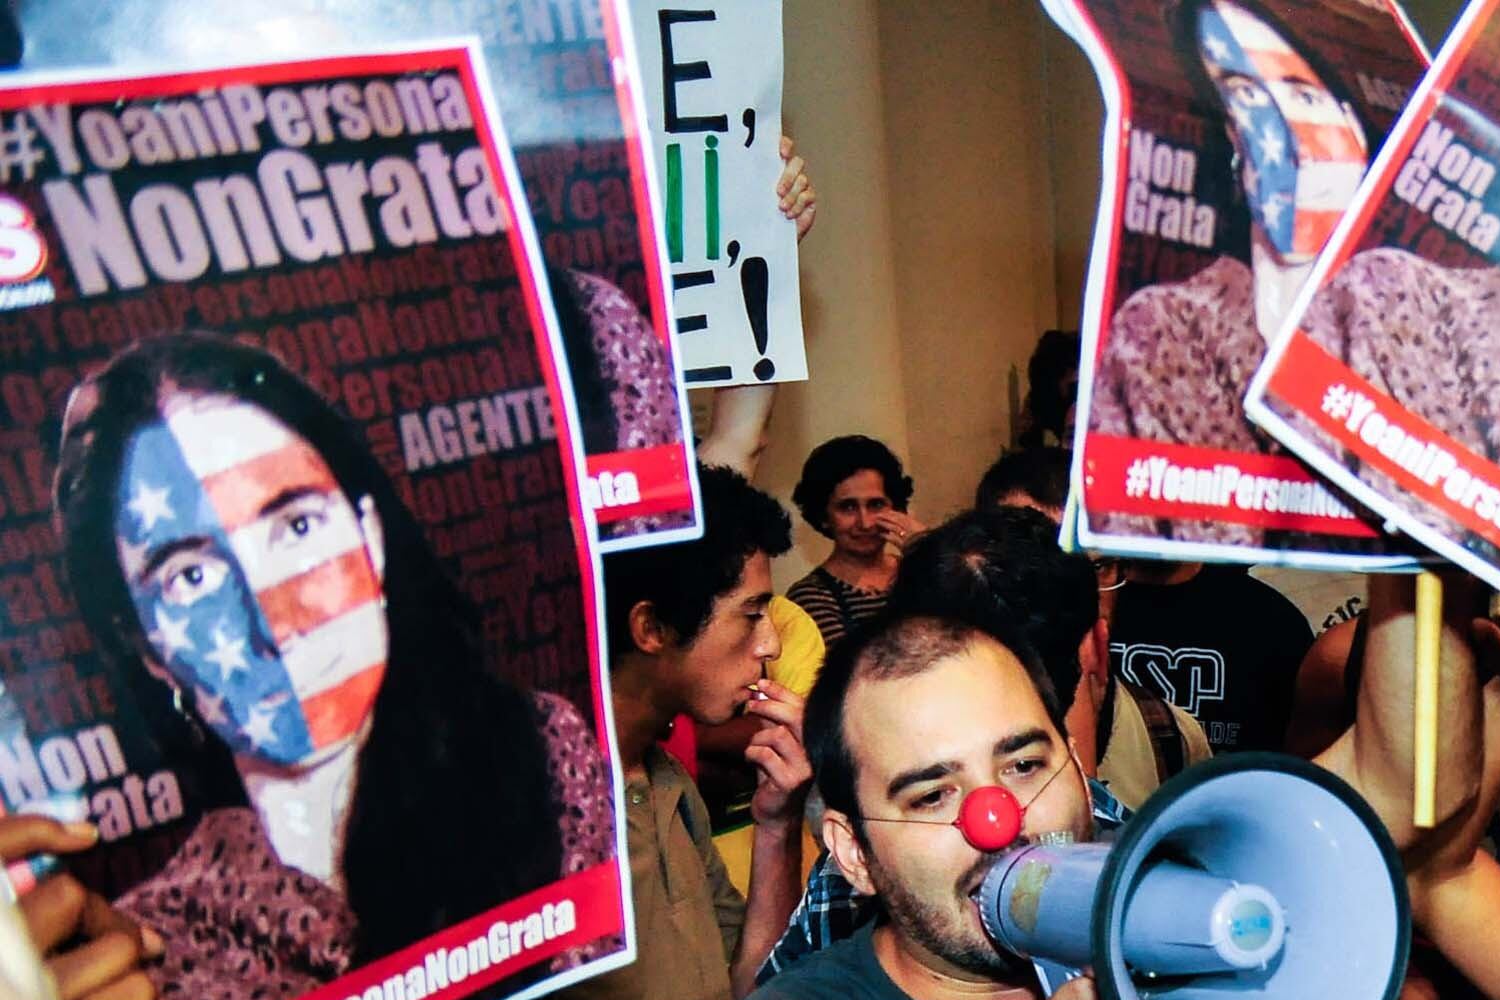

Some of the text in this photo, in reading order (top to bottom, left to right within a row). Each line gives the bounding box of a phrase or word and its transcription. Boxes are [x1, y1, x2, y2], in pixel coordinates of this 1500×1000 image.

[0, 73, 472, 182] #YoaniPersona
[1129, 129, 1198, 193] Non
[1412, 120, 1496, 199] Non
[42, 142, 515, 296] NonGrata
[1124, 178, 1217, 249] Grata
[400, 384, 558, 473] AGENTE
[1109, 642, 1225, 718] SP
